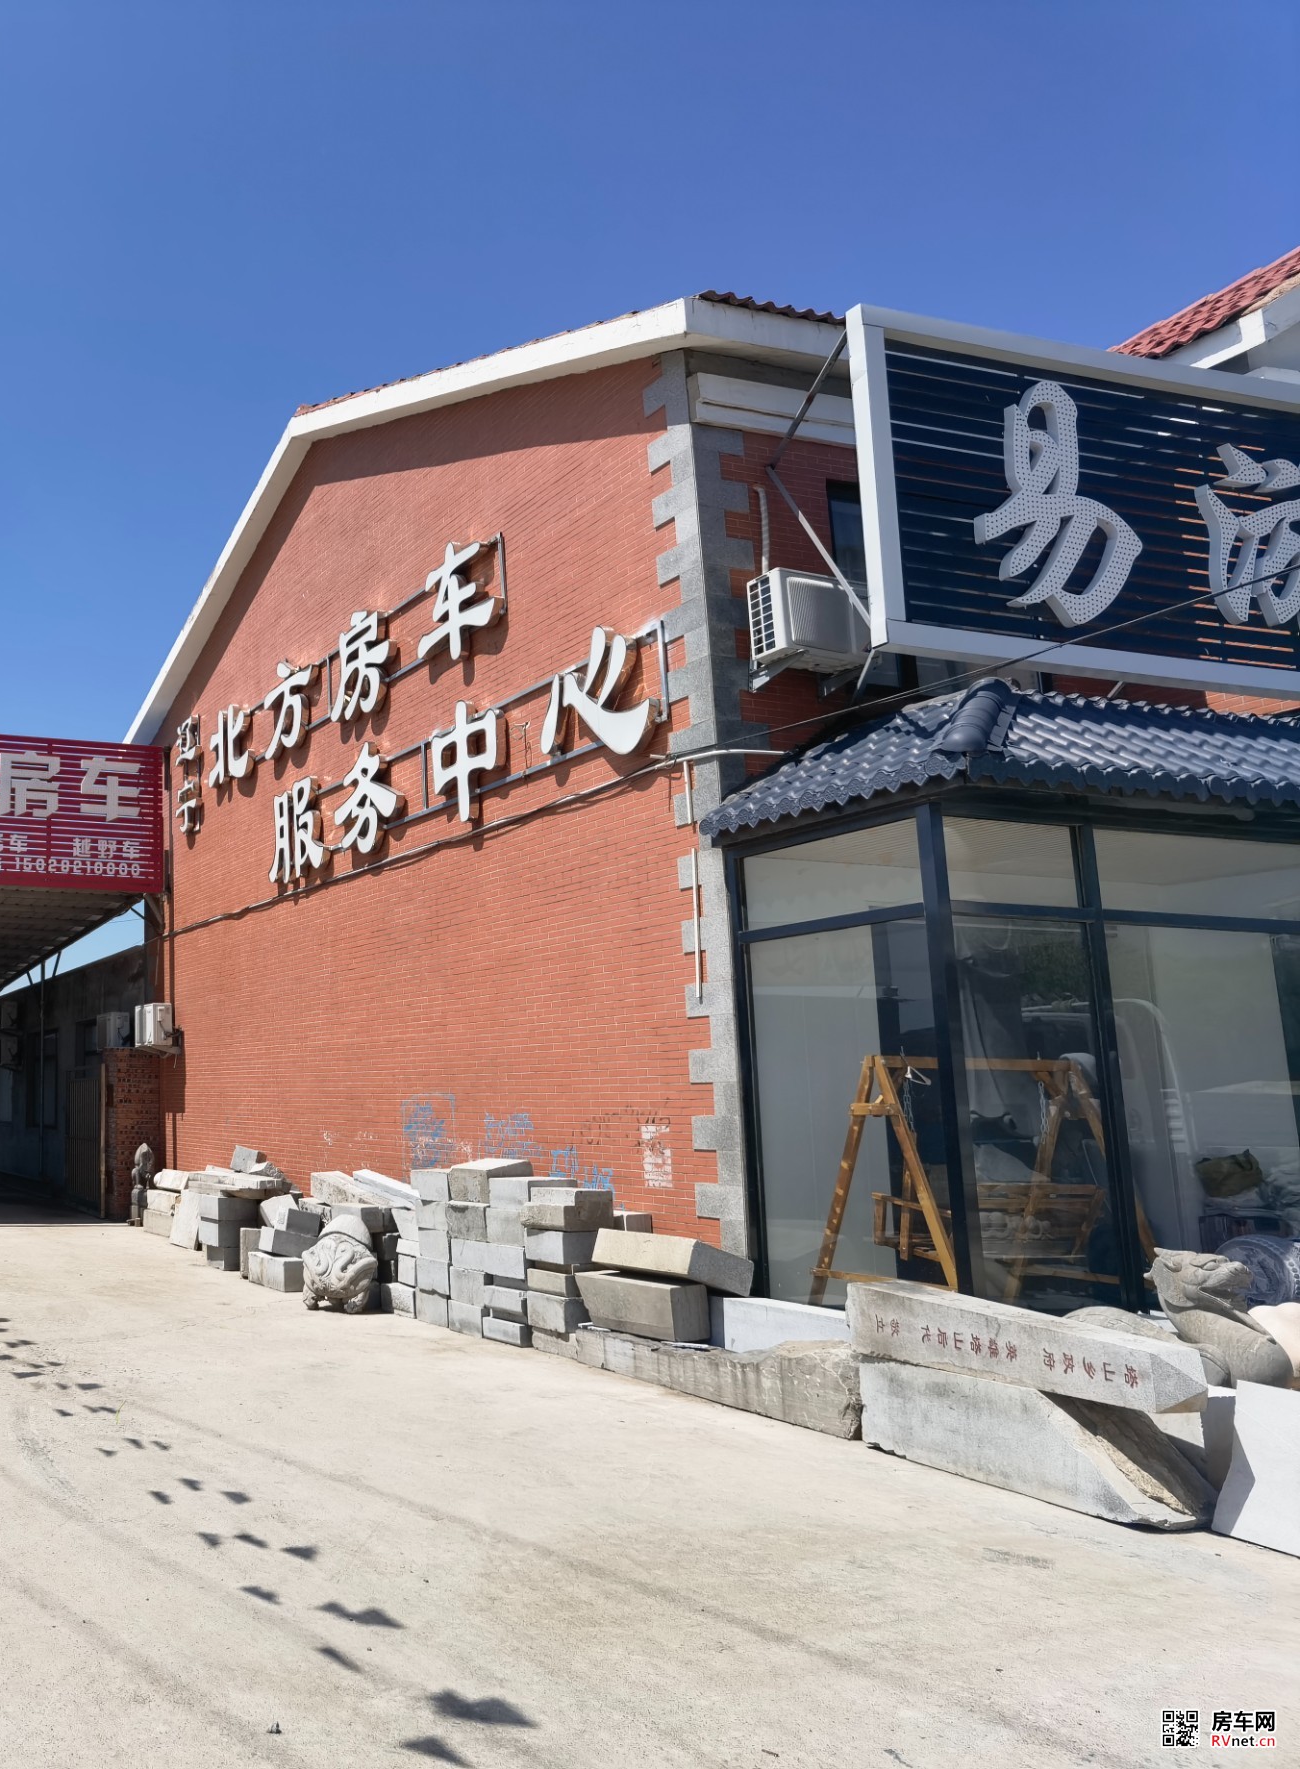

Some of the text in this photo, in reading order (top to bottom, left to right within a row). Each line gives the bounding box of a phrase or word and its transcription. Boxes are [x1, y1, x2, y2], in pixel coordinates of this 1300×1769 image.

[208, 541, 501, 789] 北方房车
[268, 626, 662, 884] 服务中心
[72, 837, 141, 860] 越野车
